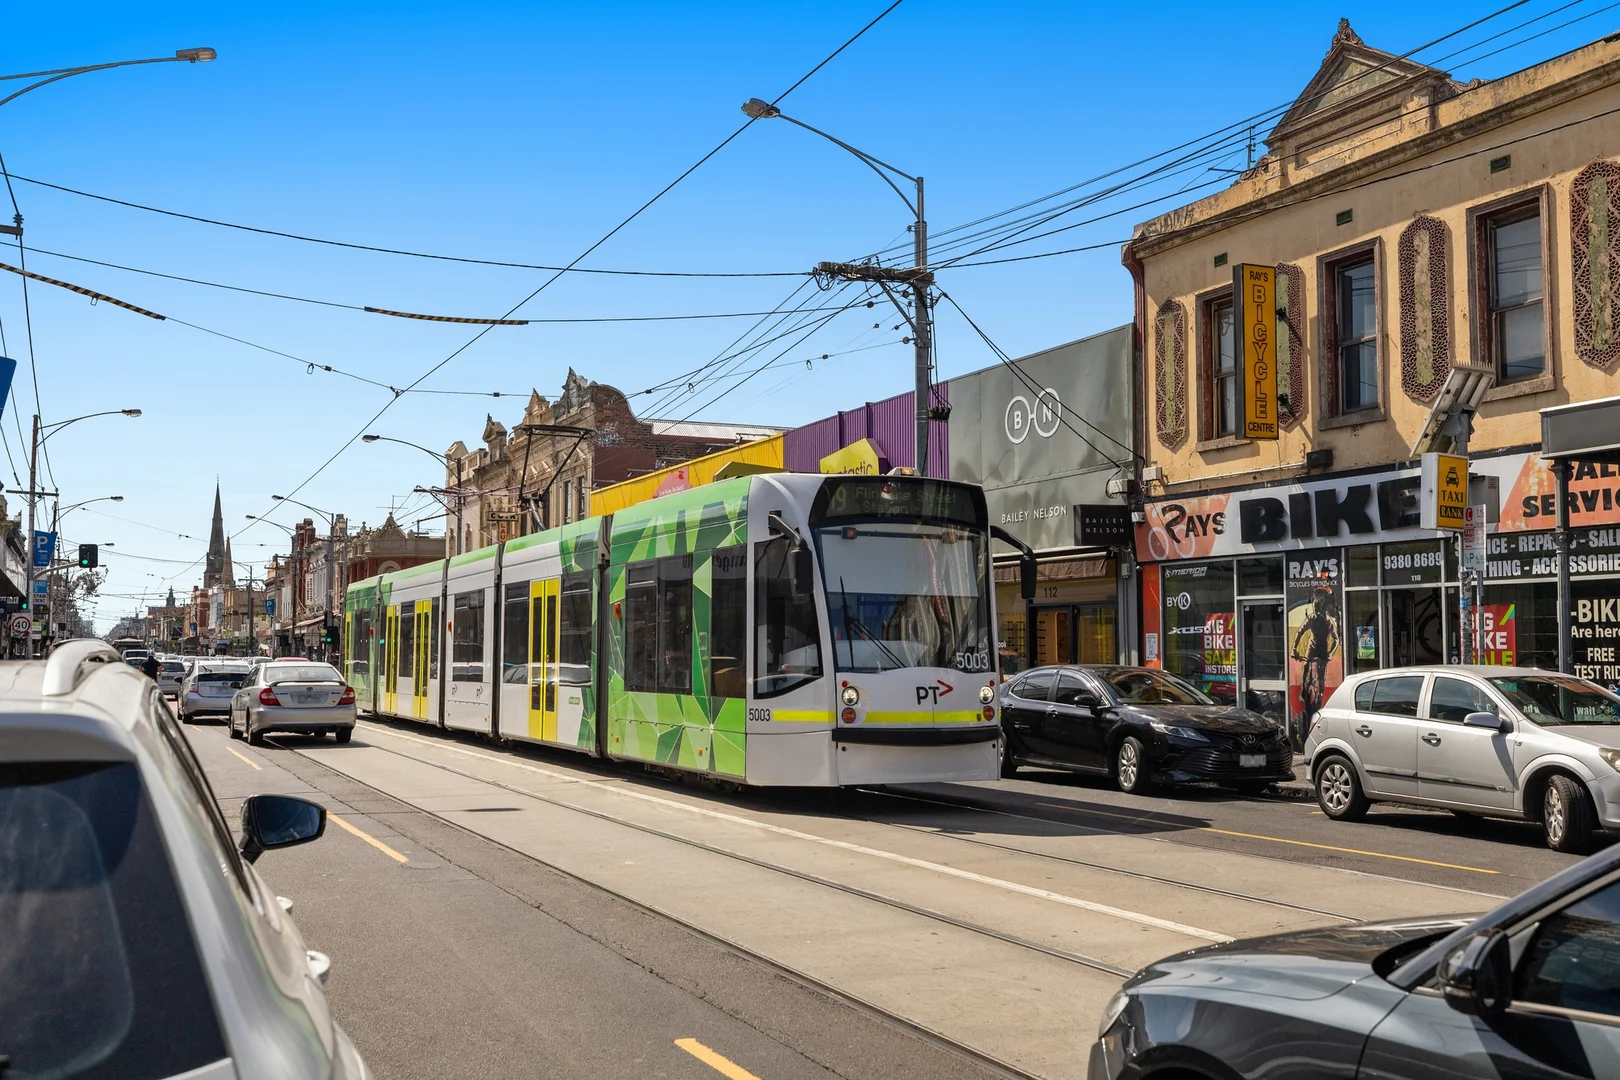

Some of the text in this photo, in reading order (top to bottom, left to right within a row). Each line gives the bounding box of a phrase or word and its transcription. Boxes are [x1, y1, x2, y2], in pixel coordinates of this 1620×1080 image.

[1250, 270, 1268, 282] RAY'S
[1252, 284, 1268, 419] BICYCLE
[1247, 421, 1274, 433] CENTRE
[1441, 490, 1464, 503] TAXI
[1001, 505, 1067, 524] BAILEY NELSON
[1239, 475, 1421, 545] BIKE
[1440, 507, 1463, 519] RANK
[1161, 503, 1227, 543] RAYS
[37, 535, 48, 549] P
[1289, 558, 1338, 579] RAY'S
[1384, 552, 1442, 570] 9380 8689
[1411, 574, 1421, 582] 110
[1044, 586, 1057, 598] 112
[15, 620, 27, 628] 40
[1204, 619, 1224, 634] BIG
[1571, 625, 1593, 638] Are
[1204, 634, 1233, 649] BIKE
[956, 652, 989, 669] 5003
[1204, 650, 1236, 665] SALE
[1587, 647, 1616, 662] FREE
[1205, 665, 1237, 674] INSTORE
[1574, 665, 1602, 680] TEST
[749, 708, 771, 721] 5003
